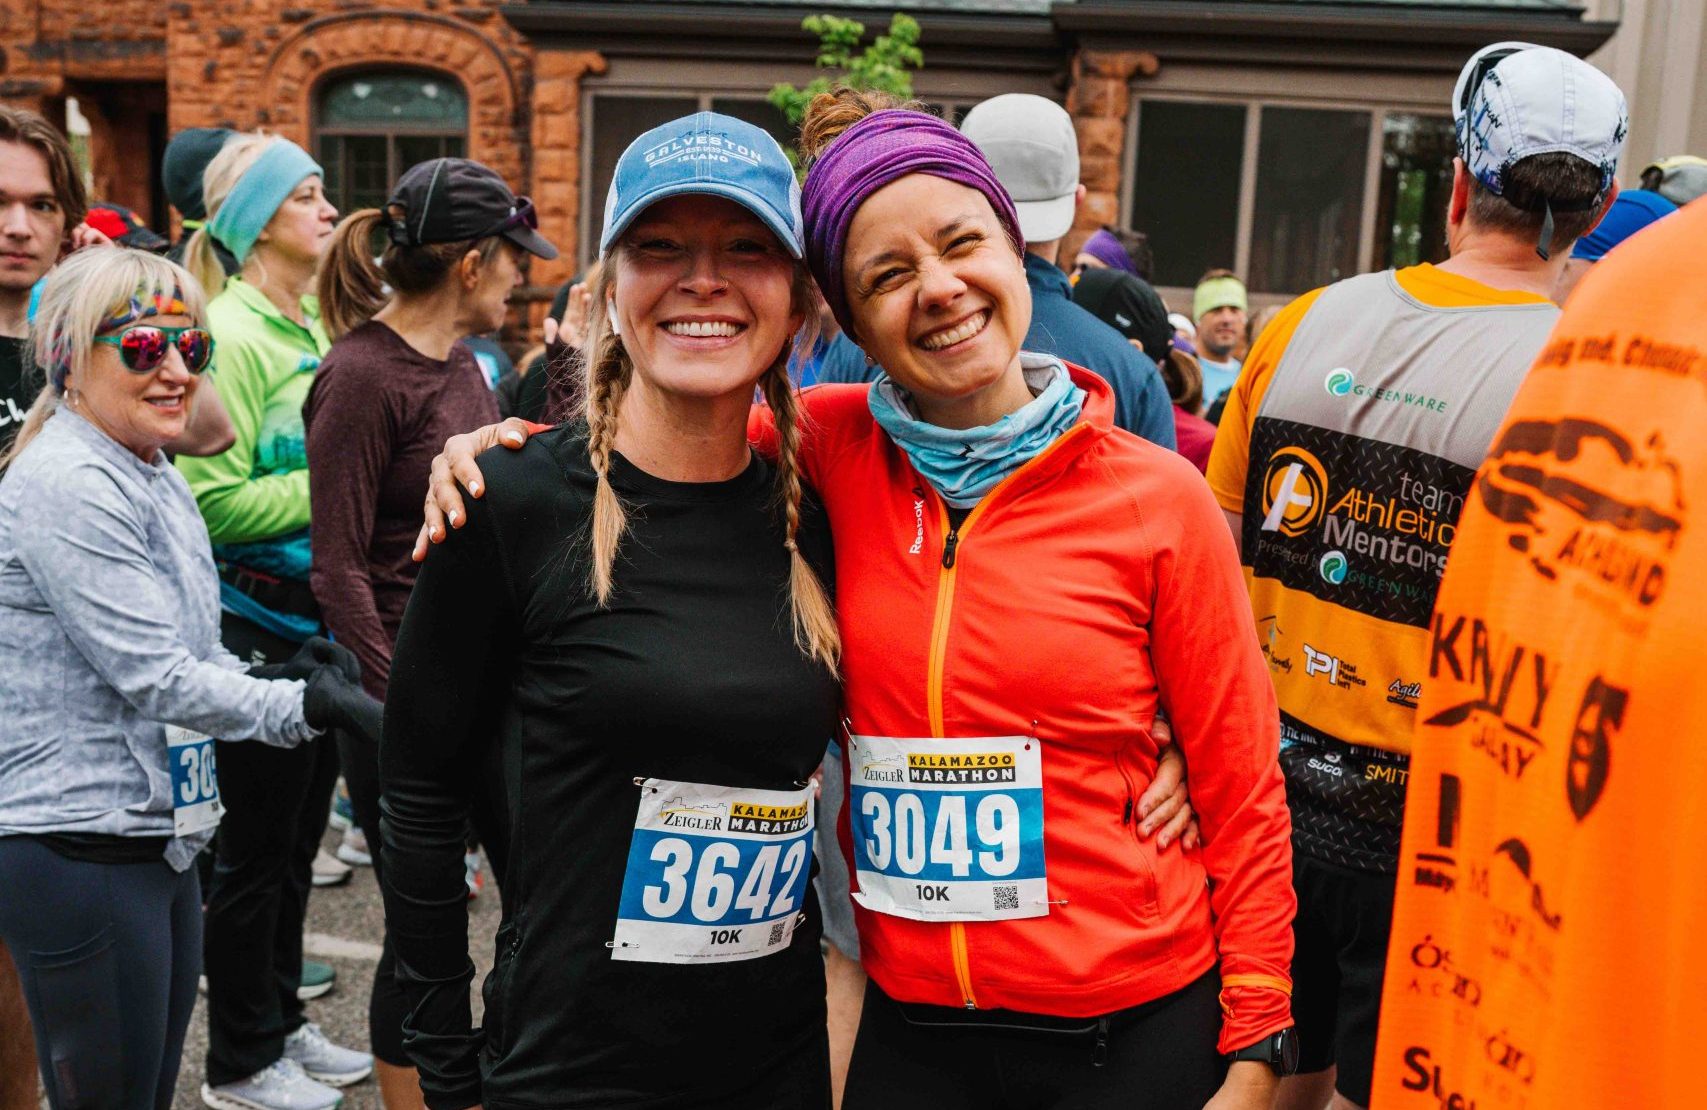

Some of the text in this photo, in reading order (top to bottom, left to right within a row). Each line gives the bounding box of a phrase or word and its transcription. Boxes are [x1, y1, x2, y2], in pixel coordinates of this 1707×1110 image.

[644, 136, 762, 163] GALVESTON
[677, 153, 729, 163] ISLAND
[1401, 472, 1463, 514] team
[909, 500, 925, 554] Reebok
[1328, 487, 1456, 547] Athletic
[1323, 515, 1450, 577] Mentors
[1303, 644, 1338, 684] TPI
[909, 753, 1012, 767] KALAMAZOO
[864, 766, 904, 783] ZEIGLER
[910, 768, 1013, 783] MARATHON
[664, 812, 722, 831] ZEIGLER
[733, 804, 807, 818] KALAMAZ
[861, 791, 1020, 877] 3049
[642, 837, 807, 922] 3642
[915, 884, 950, 902] 10K
[710, 929, 742, 945] 10K
